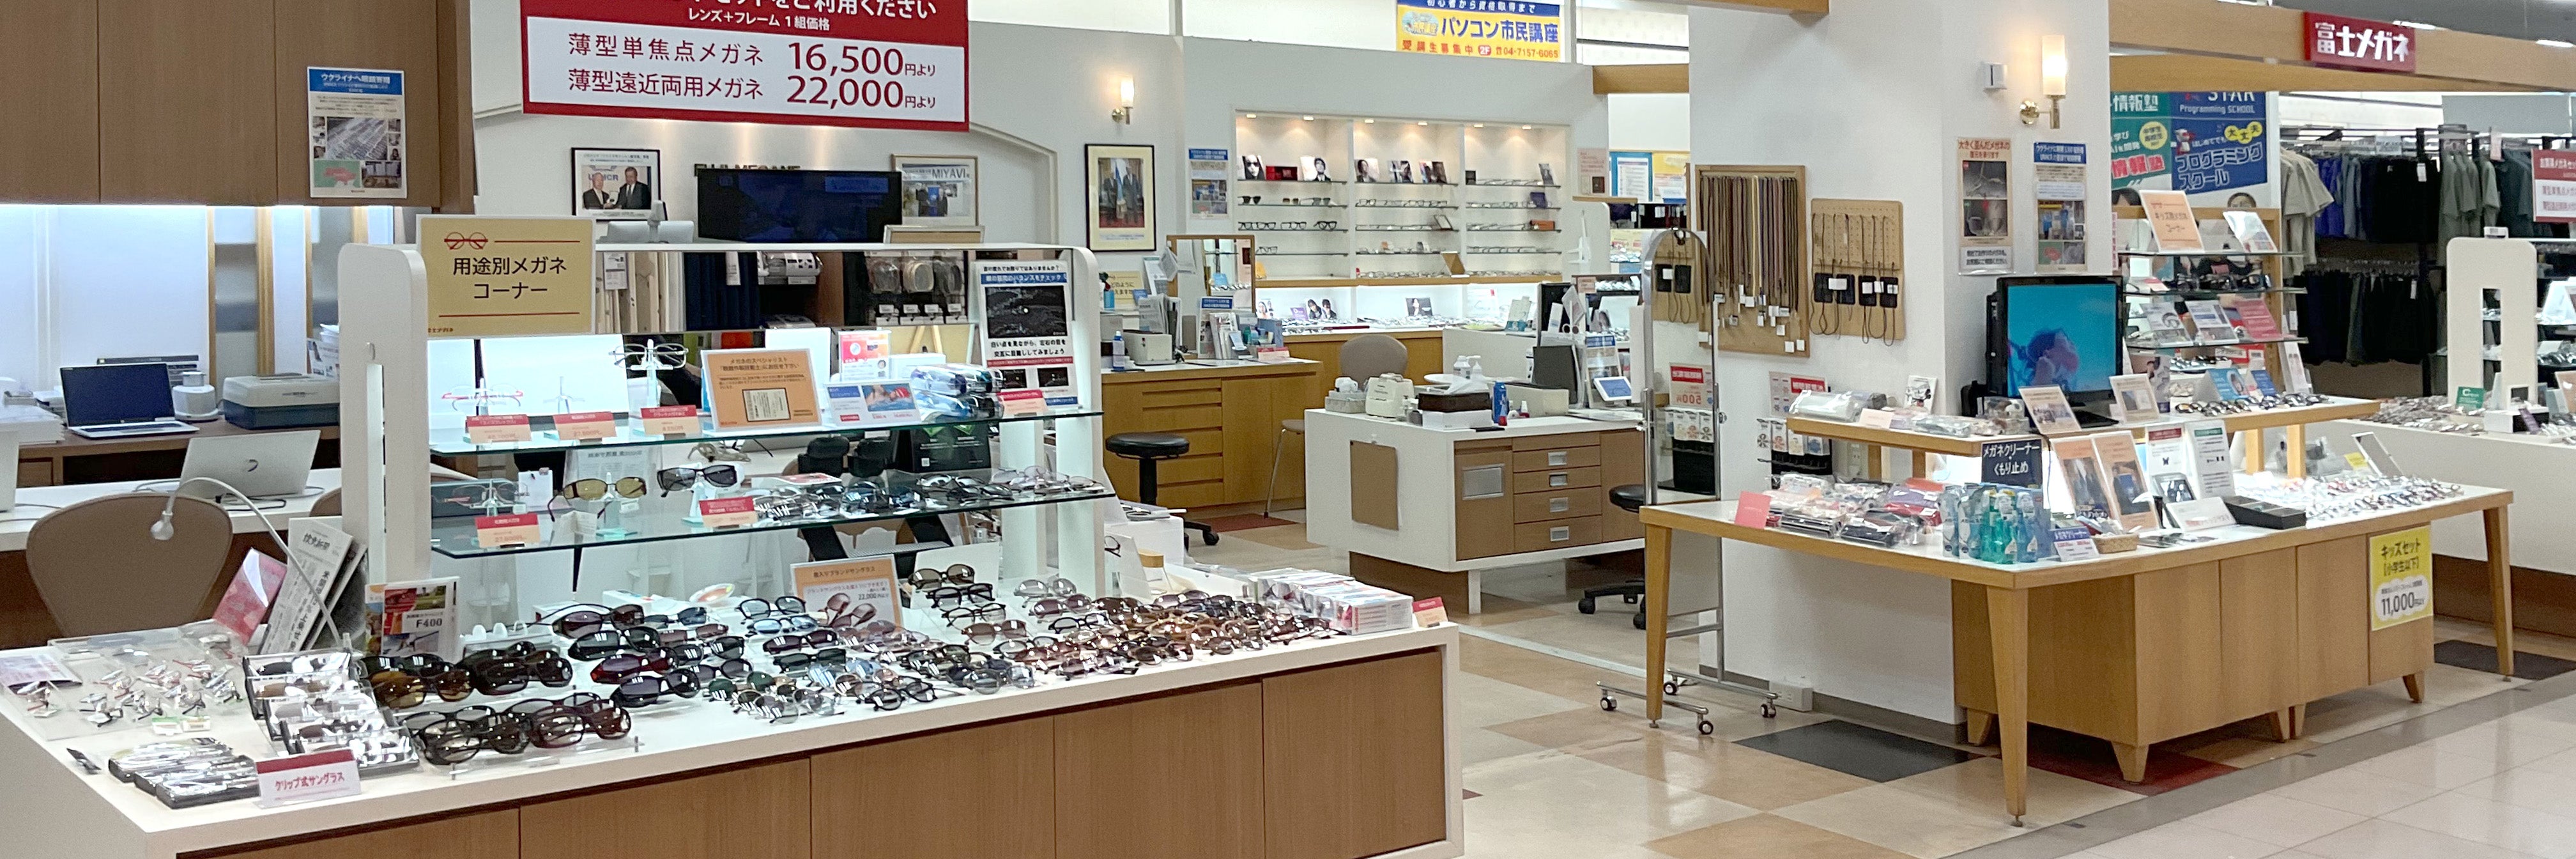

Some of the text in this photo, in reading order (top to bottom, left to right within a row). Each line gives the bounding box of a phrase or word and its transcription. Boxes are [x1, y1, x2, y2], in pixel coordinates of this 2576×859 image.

[1441, 17, 1558, 43] パソコン市民講座
[569, 33, 764, 66] 薄型単焦点メガネ
[1479, 45, 1491, 55] 2F
[2315, 22, 2409, 62] 富士メガネ
[569, 69, 764, 99] 薄型遠近両用メガネ
[2179, 104, 2255, 114] Programming SCHOOL
[2175, 141, 2263, 173] プログラミング
[2179, 168, 2230, 190] スクール
[452, 256, 567, 275] 用途別メガネ
[473, 282, 548, 299] コーナー
[1982, 442, 2041, 458] メガネクリーナー
[1994, 462, 2028, 476] くもり止め
[2381, 538, 2421, 560] キッズセット
[416, 617, 443, 628] F400
[275, 771, 345, 791] クリップ式サングラス
